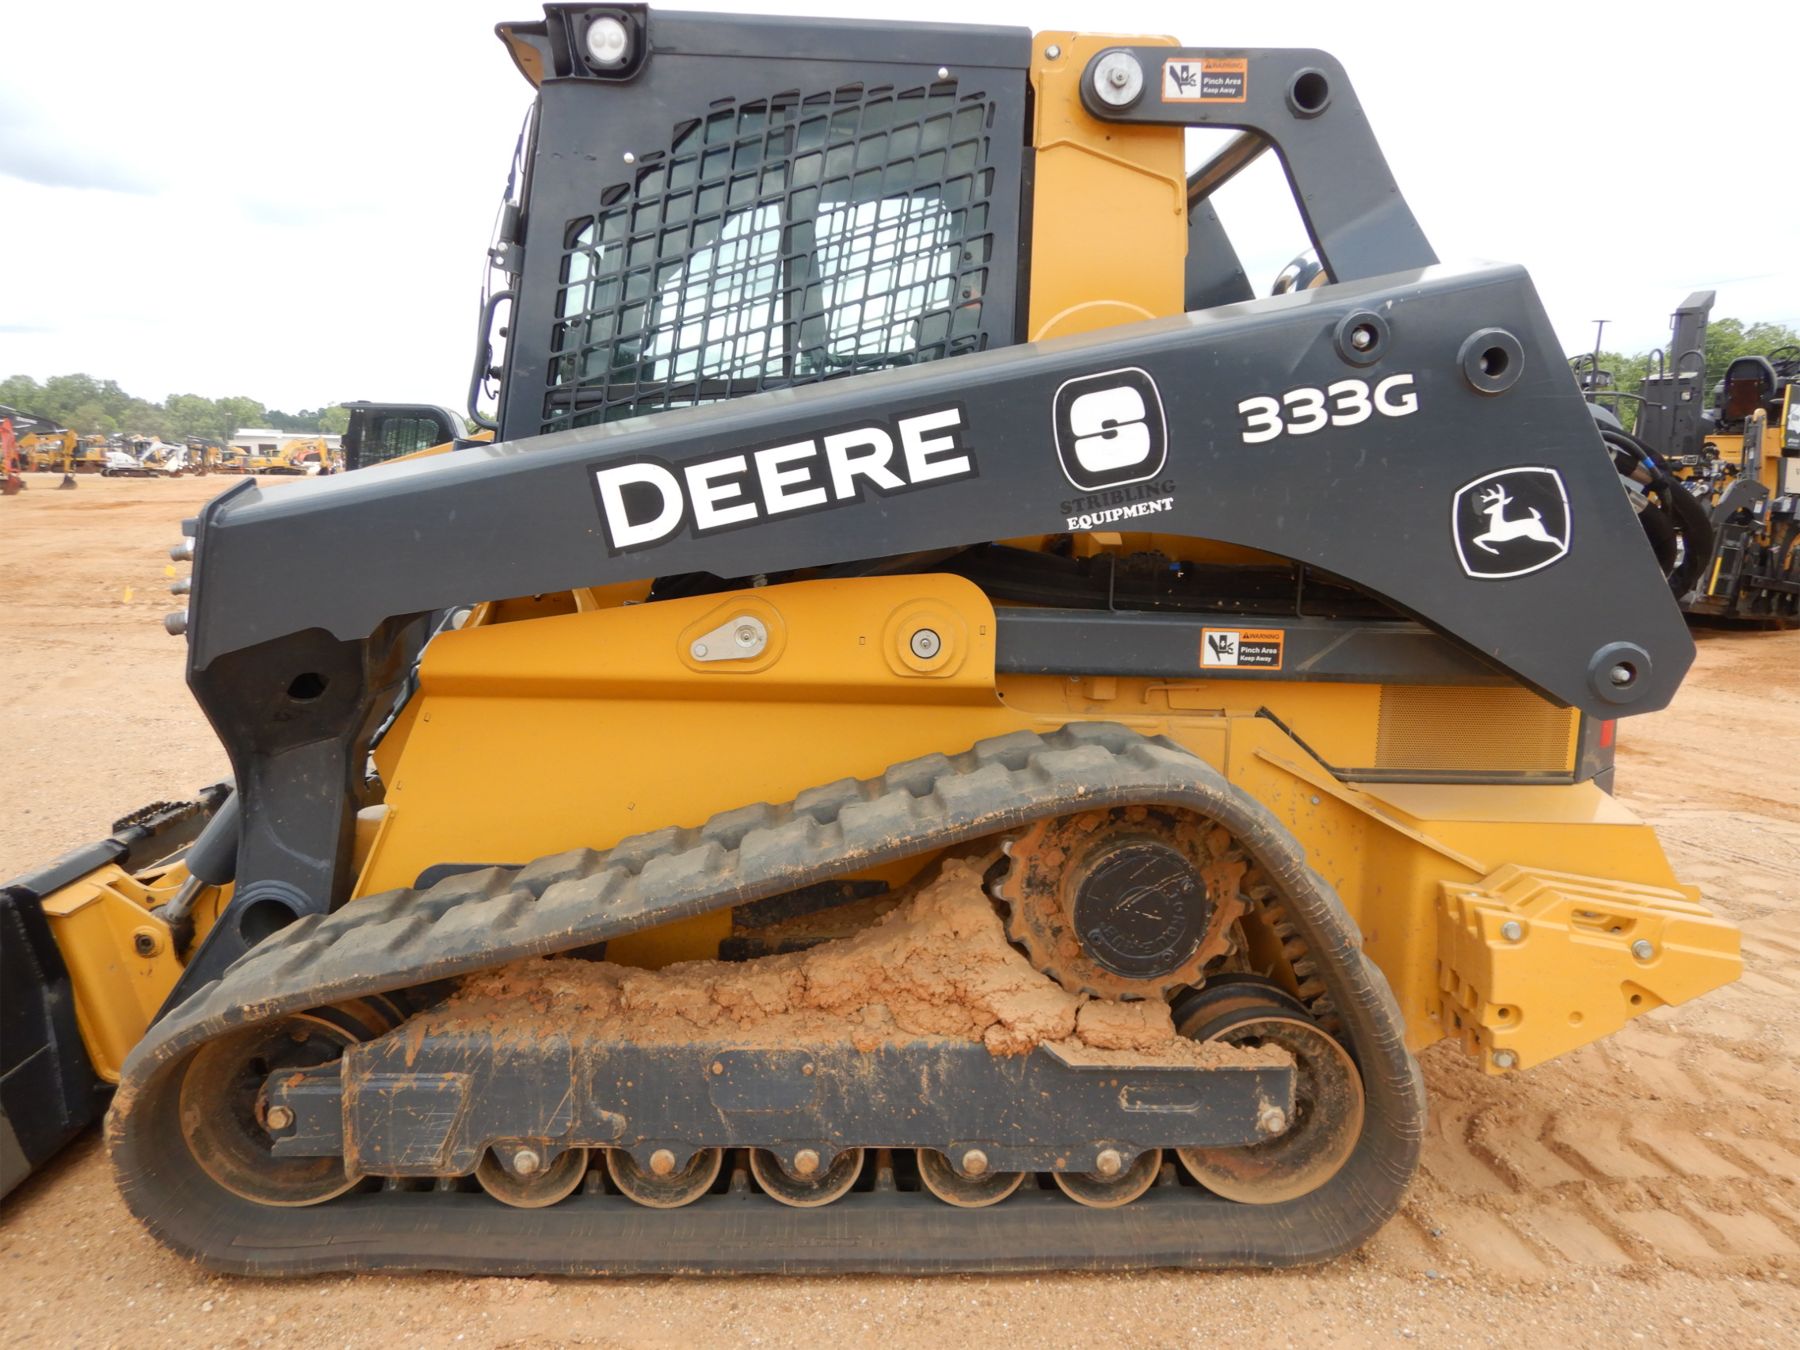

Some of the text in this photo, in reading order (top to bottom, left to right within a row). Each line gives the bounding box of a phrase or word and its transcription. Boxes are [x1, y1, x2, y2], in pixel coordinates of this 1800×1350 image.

[1203, 77, 1241, 85] Pinch Area
[1219, 87, 1236, 95] Away
[1238, 373, 1419, 444] 333G
[596, 408, 971, 549] DEERE
[1059, 479, 1177, 515] STRIBLING
[1066, 497, 1174, 531] EQUIPMENT
[1241, 646, 1260, 654] Pinch
